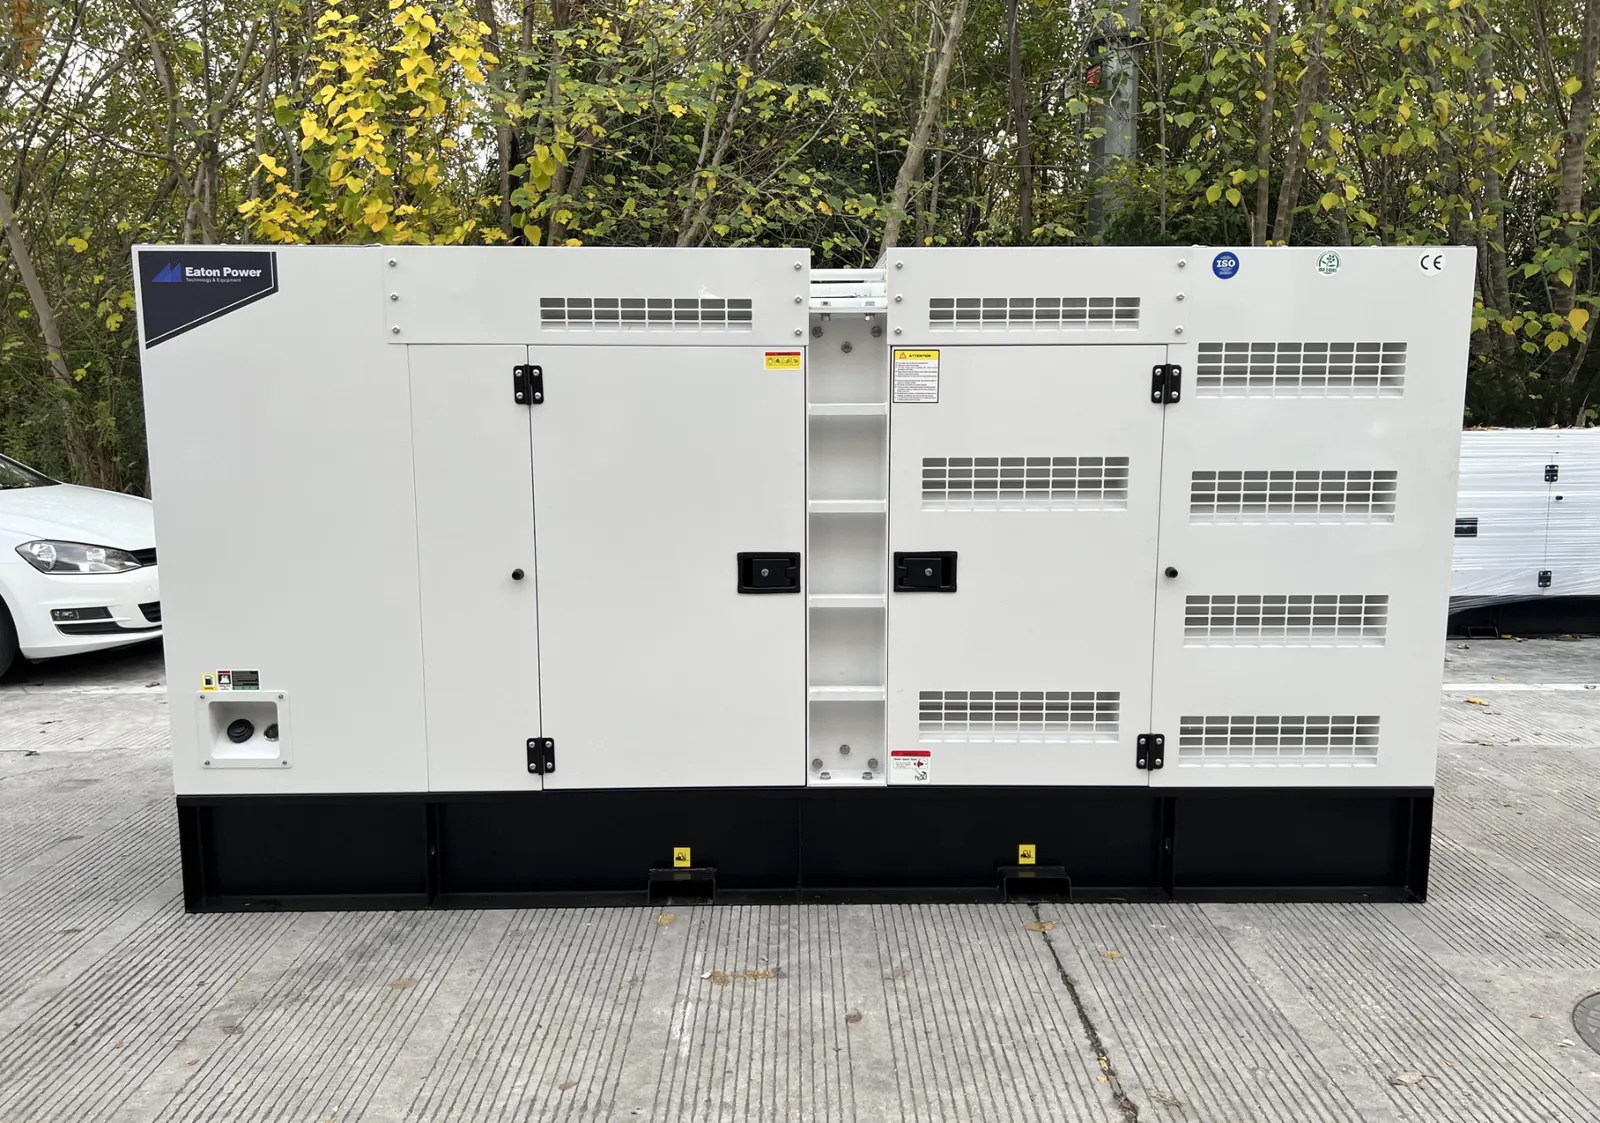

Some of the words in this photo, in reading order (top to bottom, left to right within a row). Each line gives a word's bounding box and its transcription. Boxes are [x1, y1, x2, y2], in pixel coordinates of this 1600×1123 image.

[1216, 259, 1236, 268] ISO
[1420, 254, 1443, 270] CE
[185, 266, 220, 277] Eaton
[222, 266, 262, 277] Power
